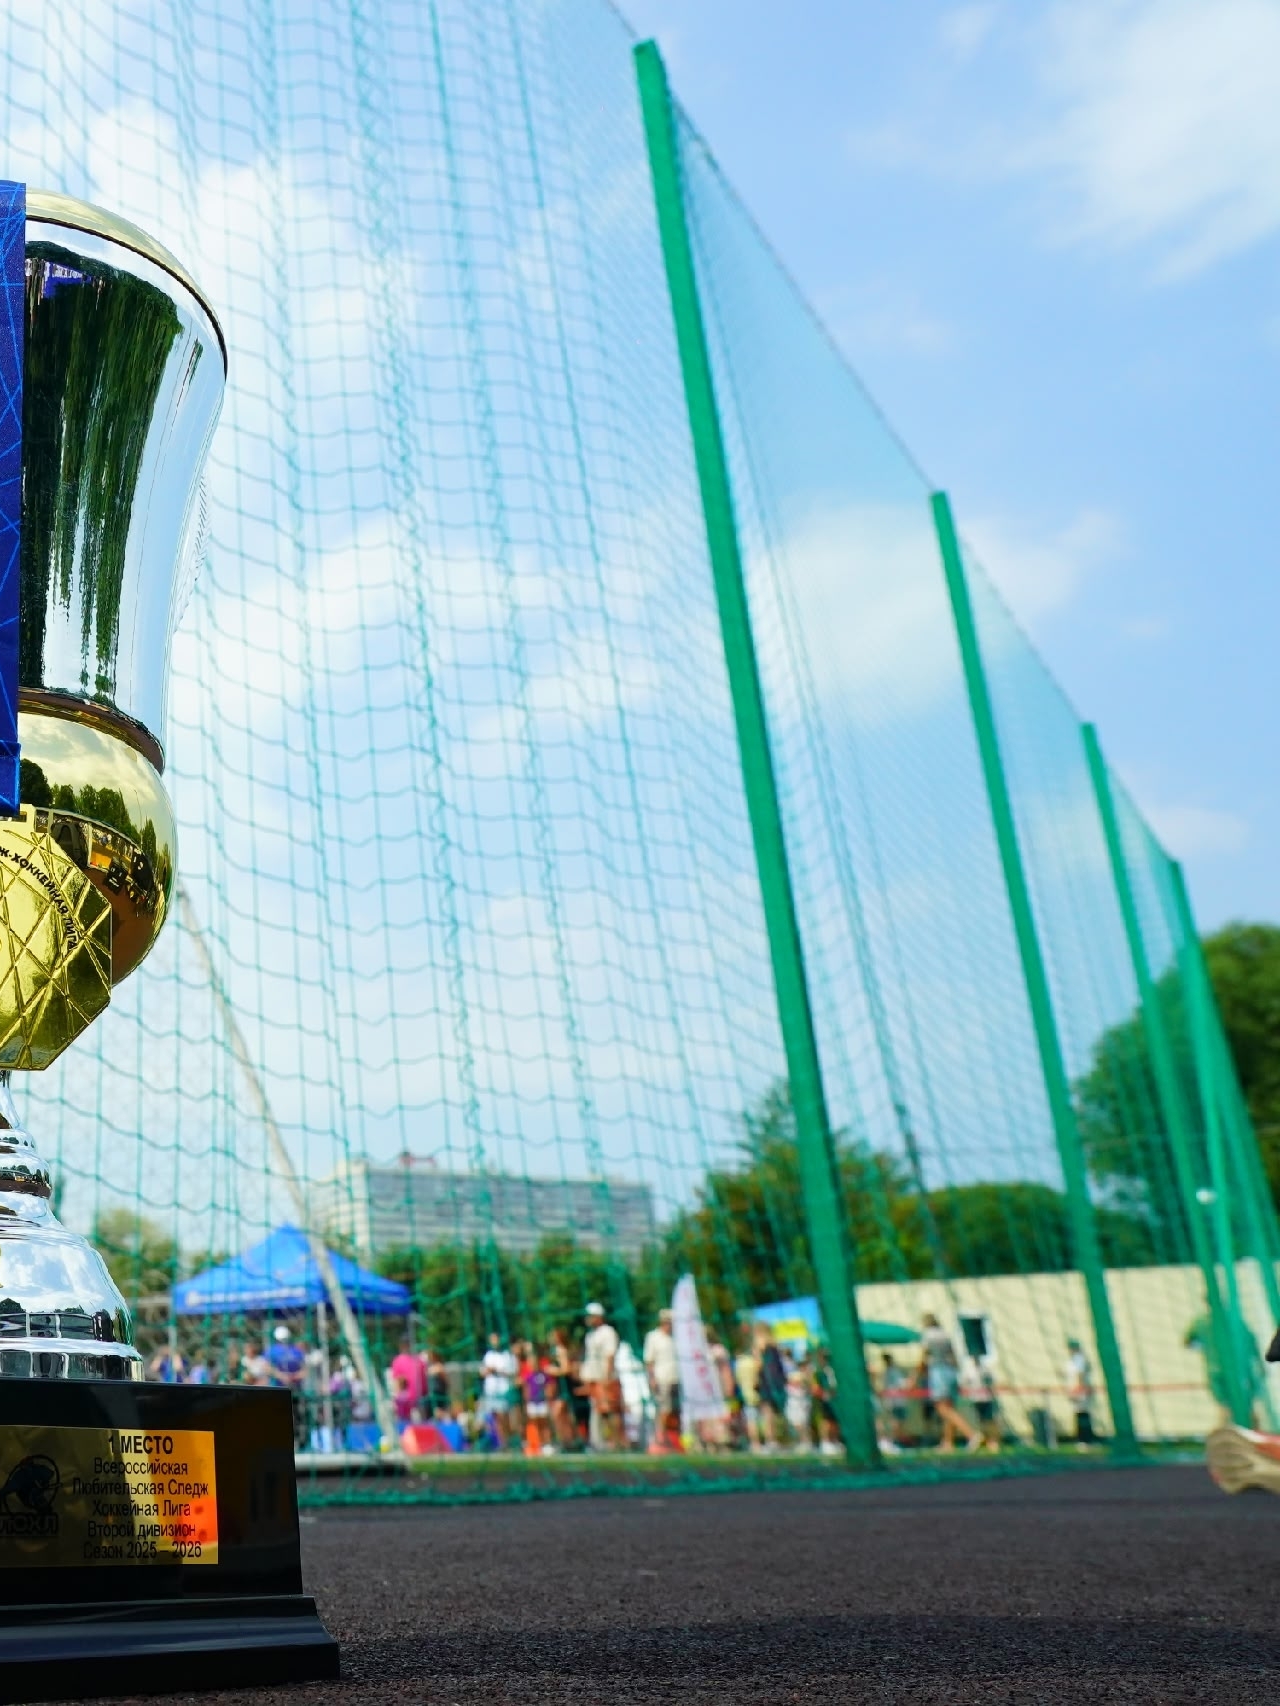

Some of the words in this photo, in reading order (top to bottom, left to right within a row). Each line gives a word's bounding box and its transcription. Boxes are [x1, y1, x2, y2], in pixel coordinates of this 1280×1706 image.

[64, 917, 81, 951] ЛИГА
[108, 1436, 115, 1454] 1
[121, 1436, 173, 1454] МЕСТО
[94, 1457, 188, 1477] Всероссийская
[72, 1478, 164, 1495] Любительская
[167, 1479, 208, 1500] Следж
[92, 1499, 159, 1516] Хоккейная
[163, 1500, 191, 1517] Лига
[88, 1520, 134, 1541] Второй
[138, 1524, 196, 1542] дивизион
[83, 1541, 123, 1559] Сезон
[127, 1541, 157, 1558] 2025
[172, 1540, 202, 1558] 2026
